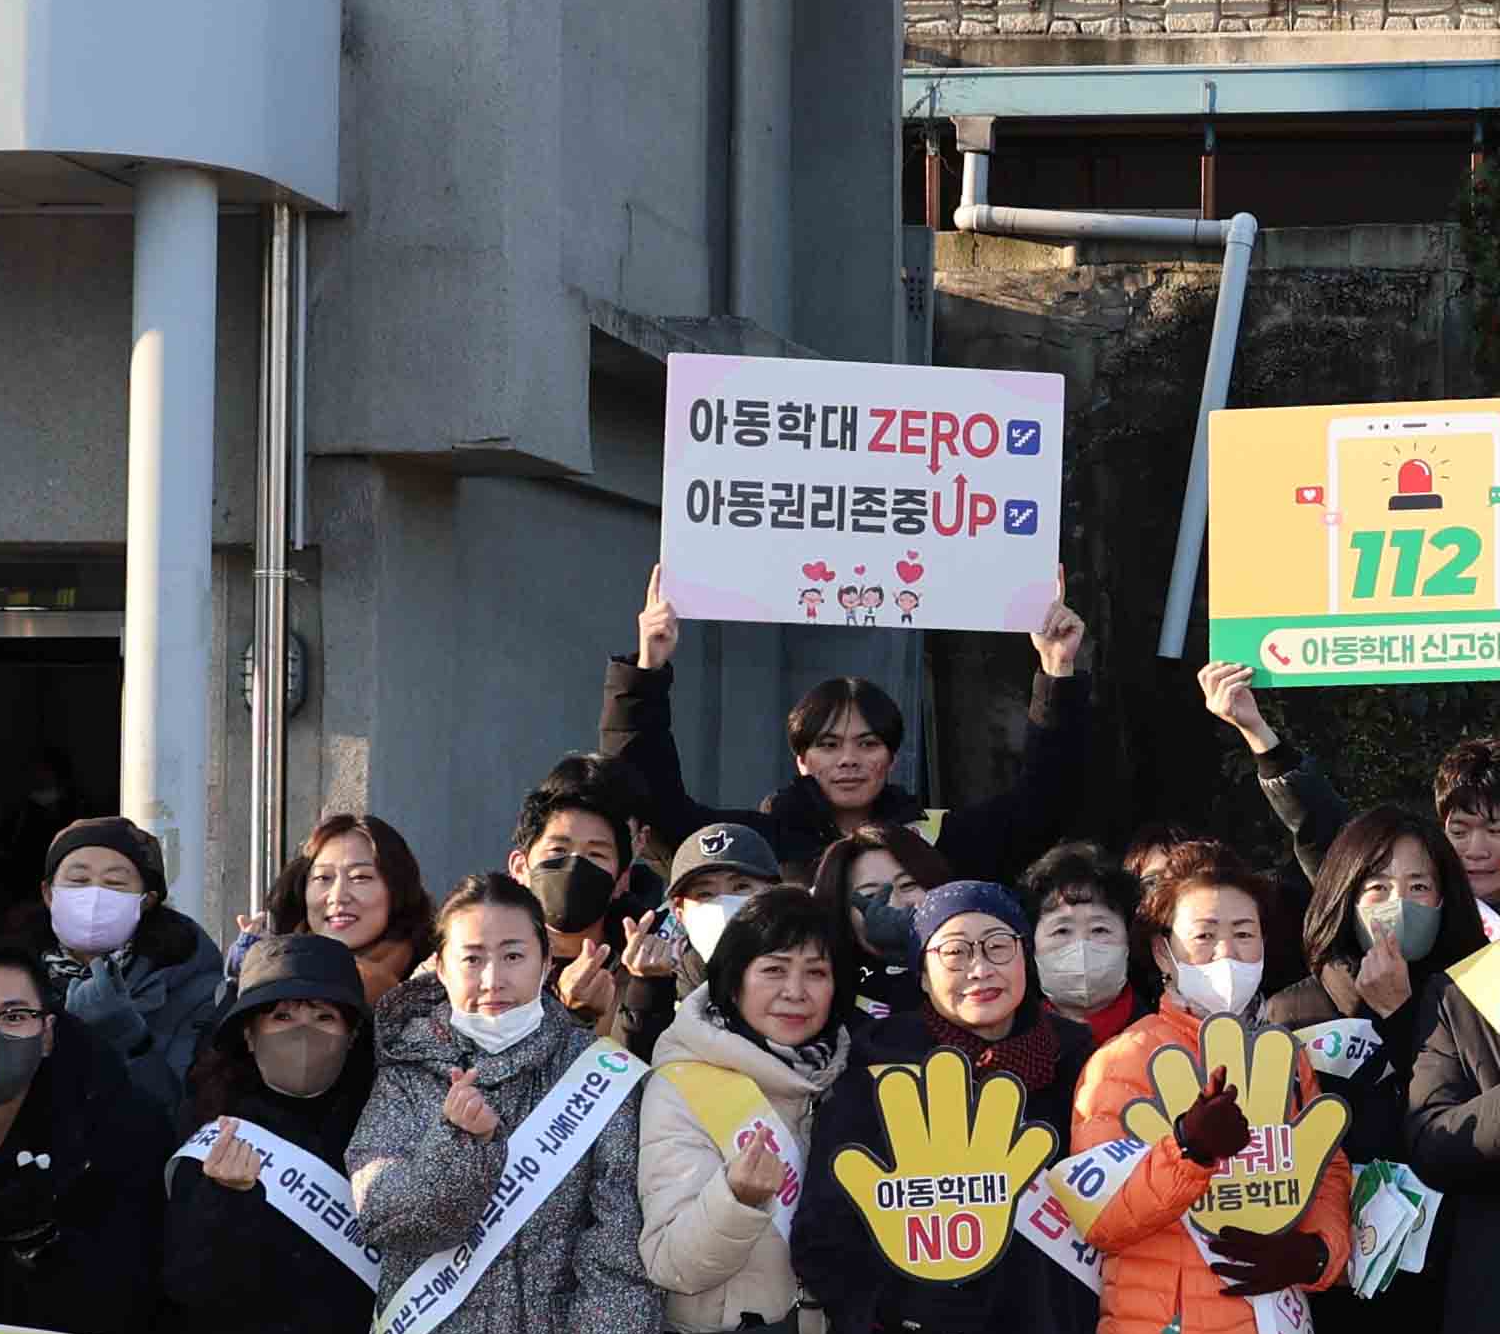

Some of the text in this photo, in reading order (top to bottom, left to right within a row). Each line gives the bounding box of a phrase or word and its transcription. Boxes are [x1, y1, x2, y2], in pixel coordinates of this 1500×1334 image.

[689, 397, 999, 473] 아동학대 ZERO
[1350, 525, 1482, 599] 112
[1302, 633, 1415, 666] 아동학대
[1216, 1125, 1292, 1177] 춰!
[876, 1172, 1009, 1208] 아동학대!
[906, 1212, 982, 1263] NO
